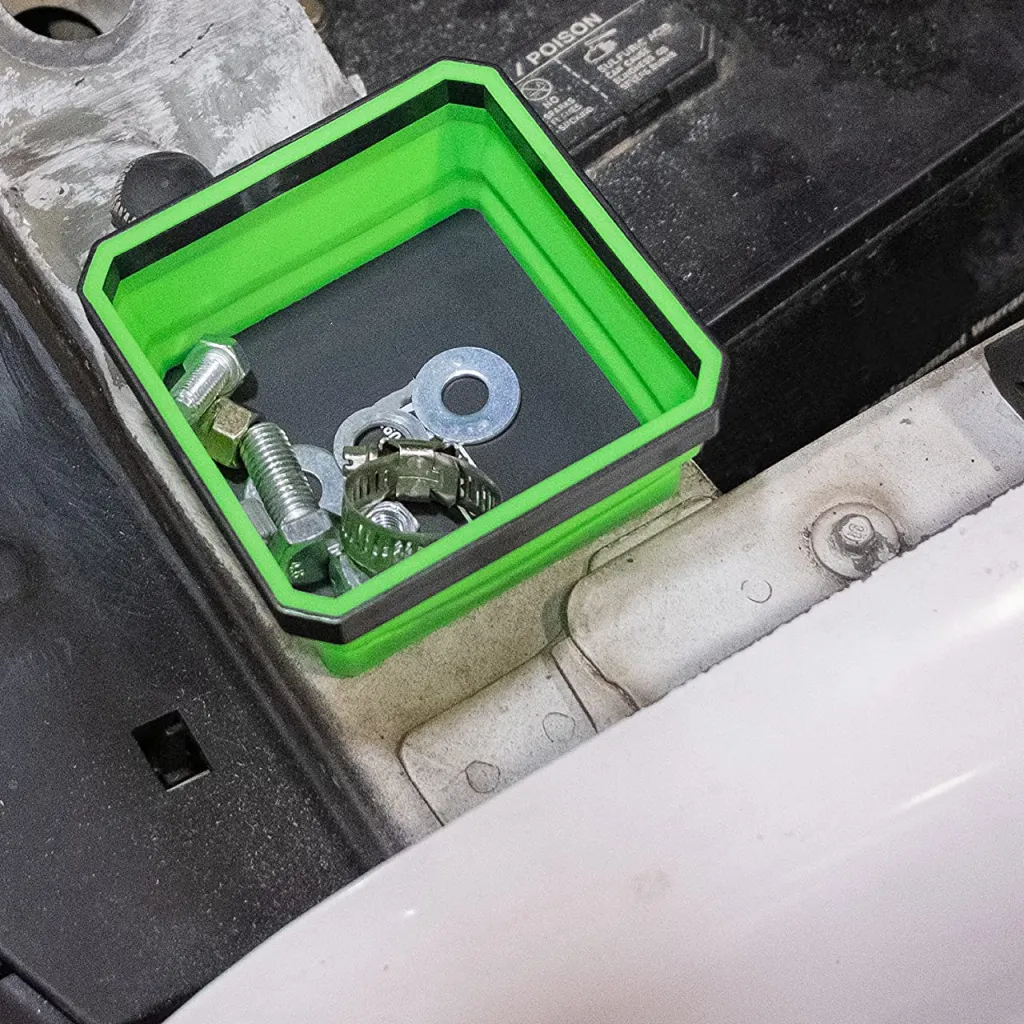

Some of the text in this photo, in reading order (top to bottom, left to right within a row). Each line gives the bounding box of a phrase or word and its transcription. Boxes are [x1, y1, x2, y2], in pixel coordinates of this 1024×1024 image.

[526, 12, 603, 66] POISON
[597, 23, 672, 73] SULFURIC ACID
[542, 95, 560, 109] NO
